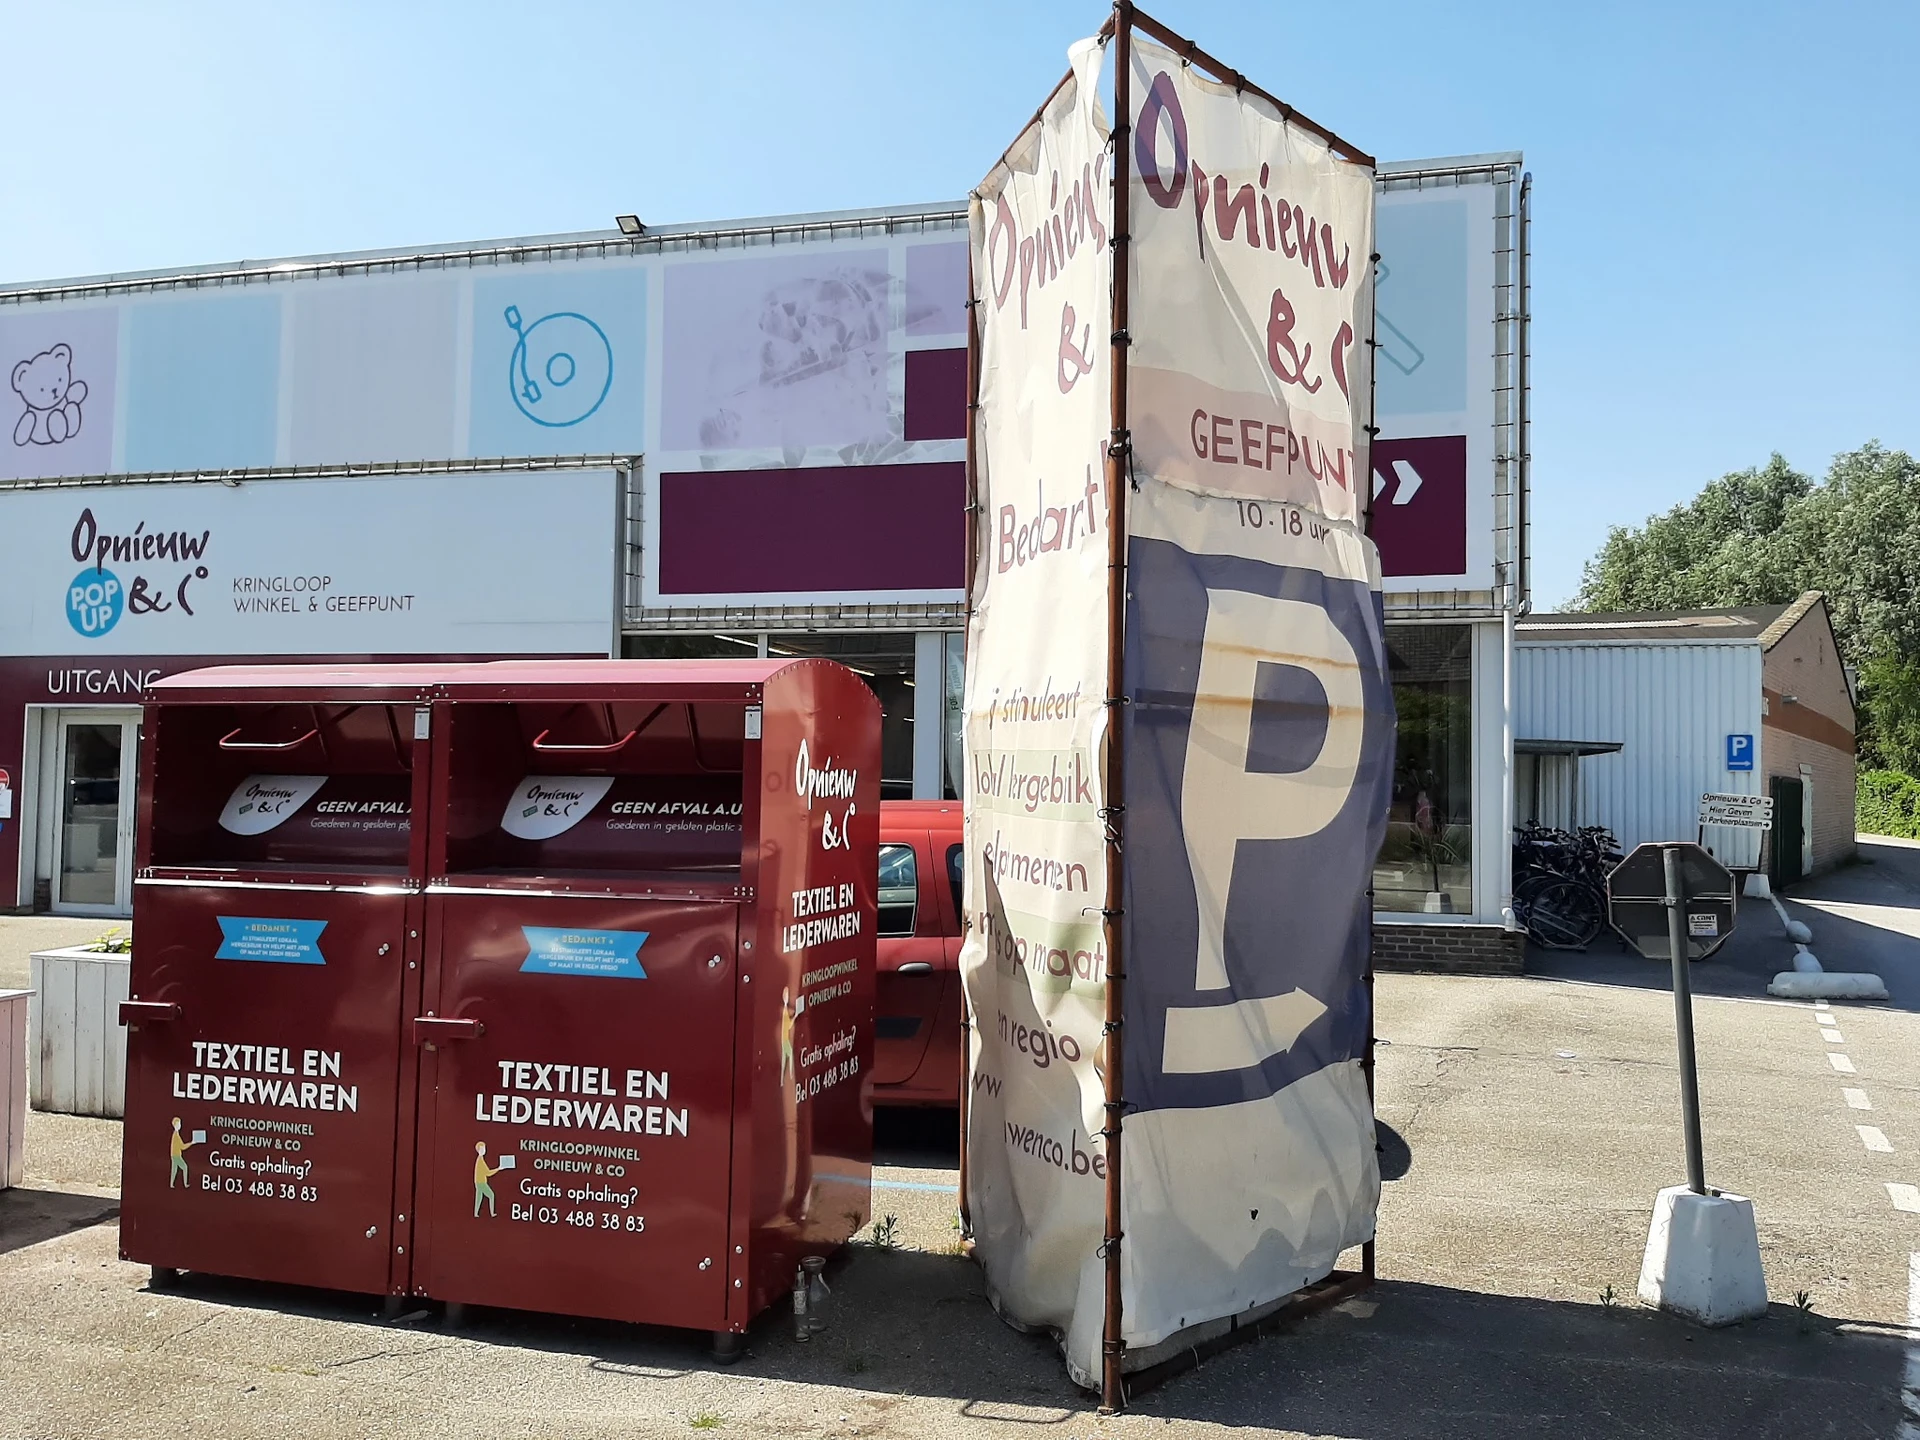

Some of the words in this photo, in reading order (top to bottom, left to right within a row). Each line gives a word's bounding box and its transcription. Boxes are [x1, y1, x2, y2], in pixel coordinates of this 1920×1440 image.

[1058, 301, 1095, 394] &
[1267, 288, 1322, 394] &
[1236, 500, 1263, 528] 10
[1281, 508, 1303, 537] 18
[71, 508, 210, 576] Opnieuw
[71, 580, 118, 611] POP
[129, 576, 172, 614] &
[233, 576, 332, 593] KRINGLOOP
[78, 604, 113, 632] UP
[233, 596, 301, 613] WINKEL
[308, 596, 318, 612] &
[325, 595, 415, 612] GEEFPUNT
[1732, 736, 1748, 757] P
[795, 738, 857, 811] Opnieuw
[246, 783, 298, 801] Opnieuw
[527, 785, 585, 803] Opnieuw
[1702, 792, 1740, 804] Opnieuw
[1749, 797, 1762, 805] Co
[257, 801, 273, 813] &
[316, 801, 357, 813] GEEN
[357, 801, 404, 814] AFVAL
[544, 803, 562, 816] &
[611, 802, 656, 814] GEEN
[658, 802, 710, 815] AFVAL
[1709, 805, 1727, 814] Hier
[1728, 807, 1753, 816] Geven
[310, 817, 350, 828] Goederen
[352, 820, 360, 828] in
[362, 818, 396, 831] gesloten
[606, 819, 651, 830] Goederen
[653, 822, 662, 830] in
[665, 820, 702, 833] gesloten
[705, 820, 735, 833] plastic
[822, 810, 841, 850] &
[792, 885, 837, 918] TEXTIEL
[839, 882, 855, 909] EN
[251, 924, 291, 932] BEDANKT
[562, 935, 606, 944] BEDANKT
[783, 911, 861, 953] LEDERWAREN
[1004, 934, 1028, 976] op
[1032, 941, 1105, 983] maat
[801, 958, 859, 988] KRINGLOOPWINKEL
[808, 987, 837, 1007] OPNIEUW
[837, 984, 842, 997] &
[842, 980, 852, 995] CO
[800, 1043, 822, 1068] Gratis
[824, 1025, 857, 1062] ophaling?
[1011, 1019, 1081, 1069] regio
[192, 1041, 295, 1075] TEXTIEL
[302, 1049, 342, 1078] EN
[172, 1072, 358, 1113] LEDERWAREN
[498, 1060, 617, 1096] TEXTIEL
[625, 1069, 669, 1100] EN
[795, 1078, 808, 1104] Bel
[809, 1076, 821, 1094] 03
[823, 1066, 837, 1089] 488
[839, 1061, 849, 1081] 38
[849, 1055, 859, 1075] 83
[210, 1115, 315, 1136] KRINGLOOPWINKEL
[475, 1093, 688, 1137] LEDERWAREN
[221, 1134, 272, 1149] OPNIEUW
[275, 1139, 283, 1150] &
[284, 1140, 301, 1151] CO
[519, 1139, 640, 1162] KRINGLOOPWINKEL
[209, 1151, 246, 1170] Gratis
[250, 1156, 312, 1180] ophaling?
[533, 1158, 592, 1174] OPNIEUW
[595, 1163, 604, 1175] &
[606, 1164, 625, 1178] CO
[202, 1174, 221, 1192] Bel
[225, 1178, 243, 1194] 03
[248, 1182, 274, 1198] 488
[279, 1184, 296, 1200] 38
[300, 1186, 318, 1202] 83
[519, 1178, 562, 1198] Gratis
[567, 1183, 639, 1209] ophaling?
[511, 1203, 533, 1221] Bel
[538, 1207, 558, 1224] 03
[565, 1210, 595, 1228] 488
[601, 1214, 620, 1231] 38
[625, 1215, 645, 1233] 83
